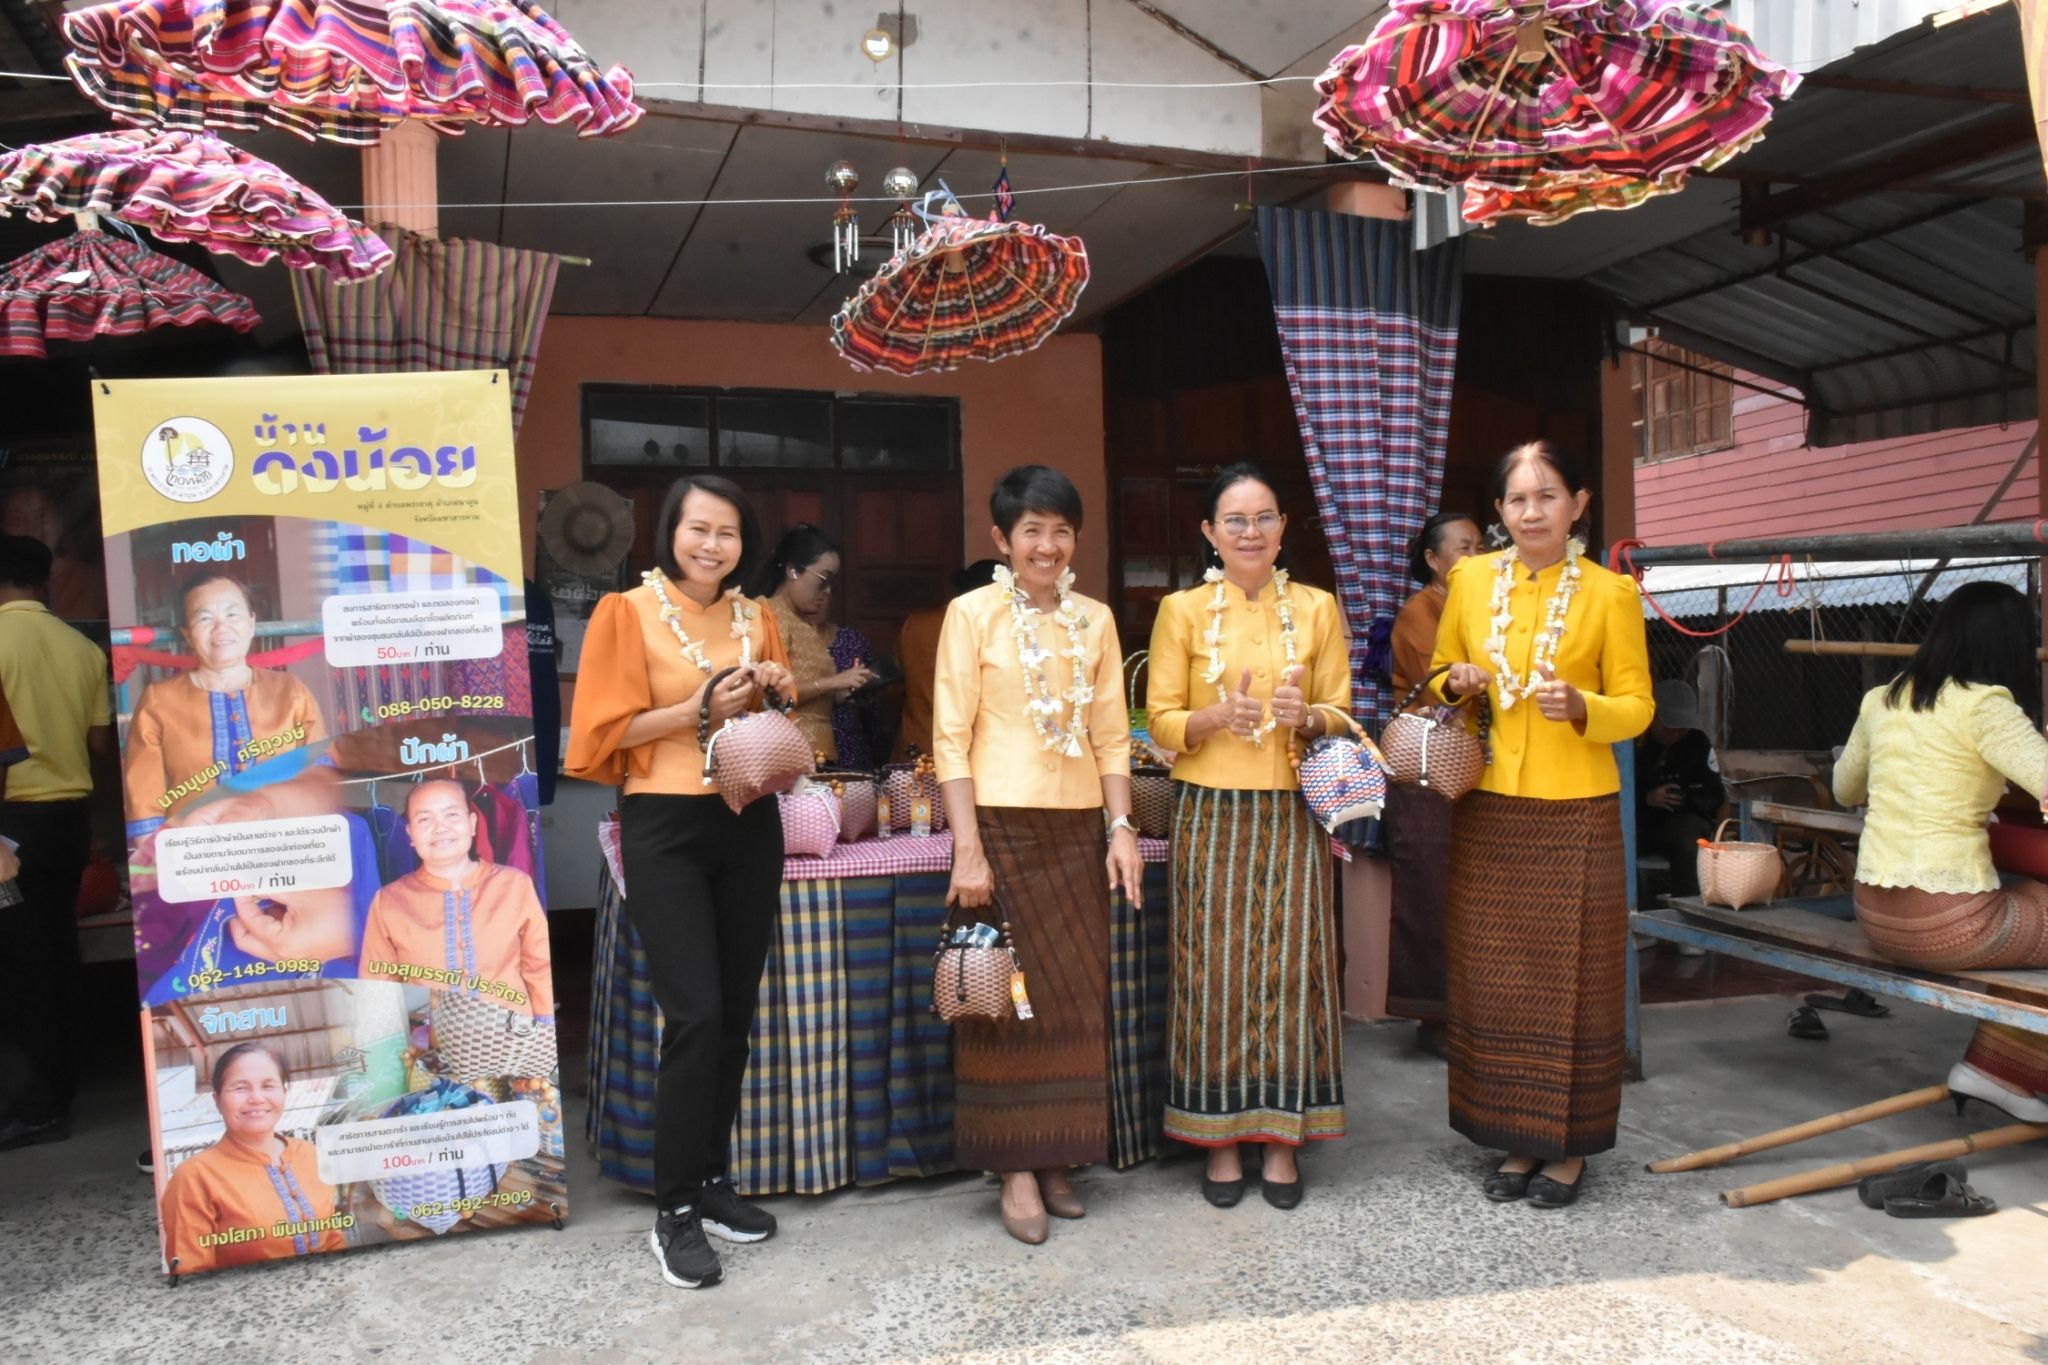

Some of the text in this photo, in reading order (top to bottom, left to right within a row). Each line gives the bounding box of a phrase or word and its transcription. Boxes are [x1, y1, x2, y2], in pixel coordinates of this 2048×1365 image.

[253, 413, 326, 447] บ้าน
[252, 426, 478, 495] ดงน้อย
[172, 531, 245, 563] ทอผ้า
[414, 645, 418, 657] /
[424, 642, 450, 656] ท่าน
[378, 695, 504, 718] 088-050-8228
[400, 733, 469, 766] ปักผ้า
[157, 722, 306, 809] นางบุบผา ศรีภูวงษ์
[258, 876, 263, 889] /
[269, 873, 296, 888] ท่าน
[188, 959, 320, 988] 062-148-0983
[368, 960, 527, 1005] นางสุพรรณี ประจิตร
[199, 1006, 287, 1034] จักสาน
[428, 1152, 433, 1164] /
[438, 1148, 464, 1162] ท่าน
[411, 1190, 532, 1218] 062-992-7909
[198, 1212, 355, 1248] นางโสภา พันนาเหนือ
